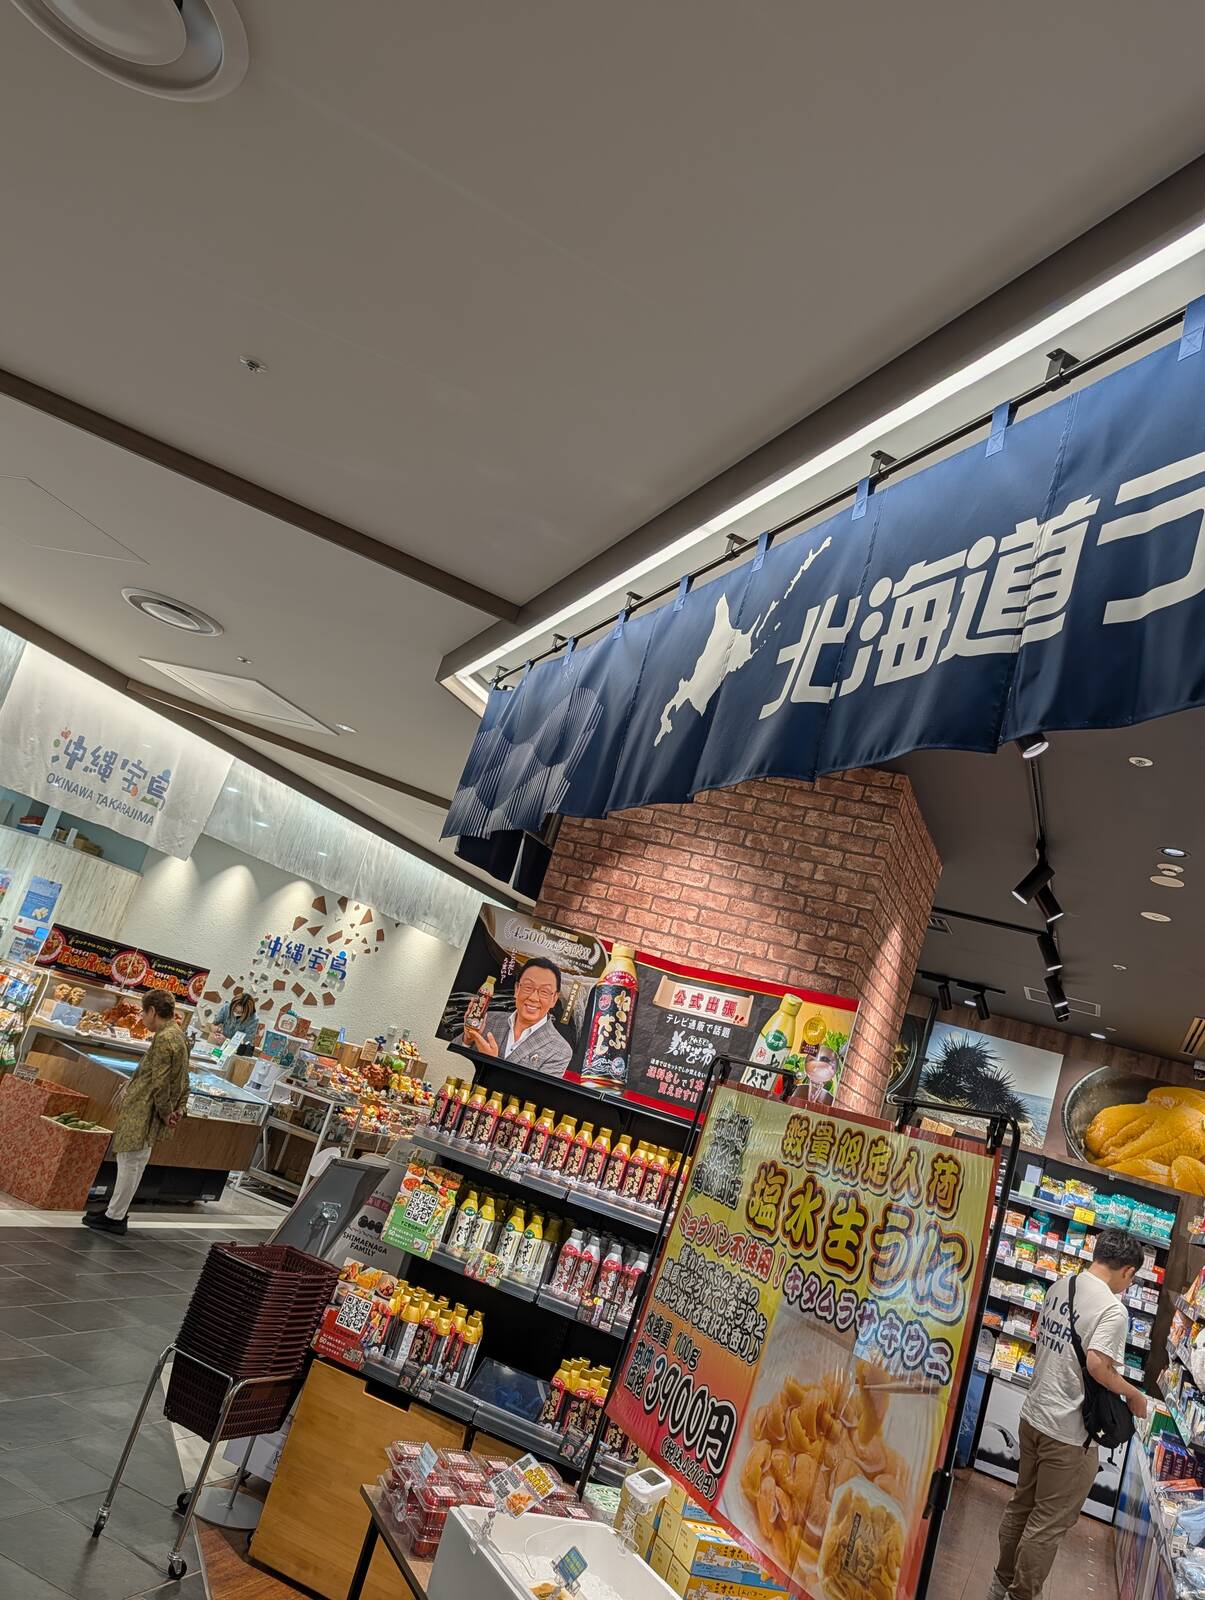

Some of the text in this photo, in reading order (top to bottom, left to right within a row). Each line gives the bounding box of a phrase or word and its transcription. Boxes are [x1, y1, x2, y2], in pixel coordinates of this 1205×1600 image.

[46, 772, 155, 826] OKINAWA TAKARAJIMA
[665, 1013, 731, 1039] テレビ通販で話題
[781, 1113, 963, 1217] 数量限定入荷
[342, 1231, 388, 1255] SHIMAENAGA
[350, 1242, 376, 1257] FAMILY
[746, 1161, 975, 1326] 塩水生うに
[783, 1267, 952, 1385] キタムラサキウニ
[643, 1352, 739, 1476] 3900円
